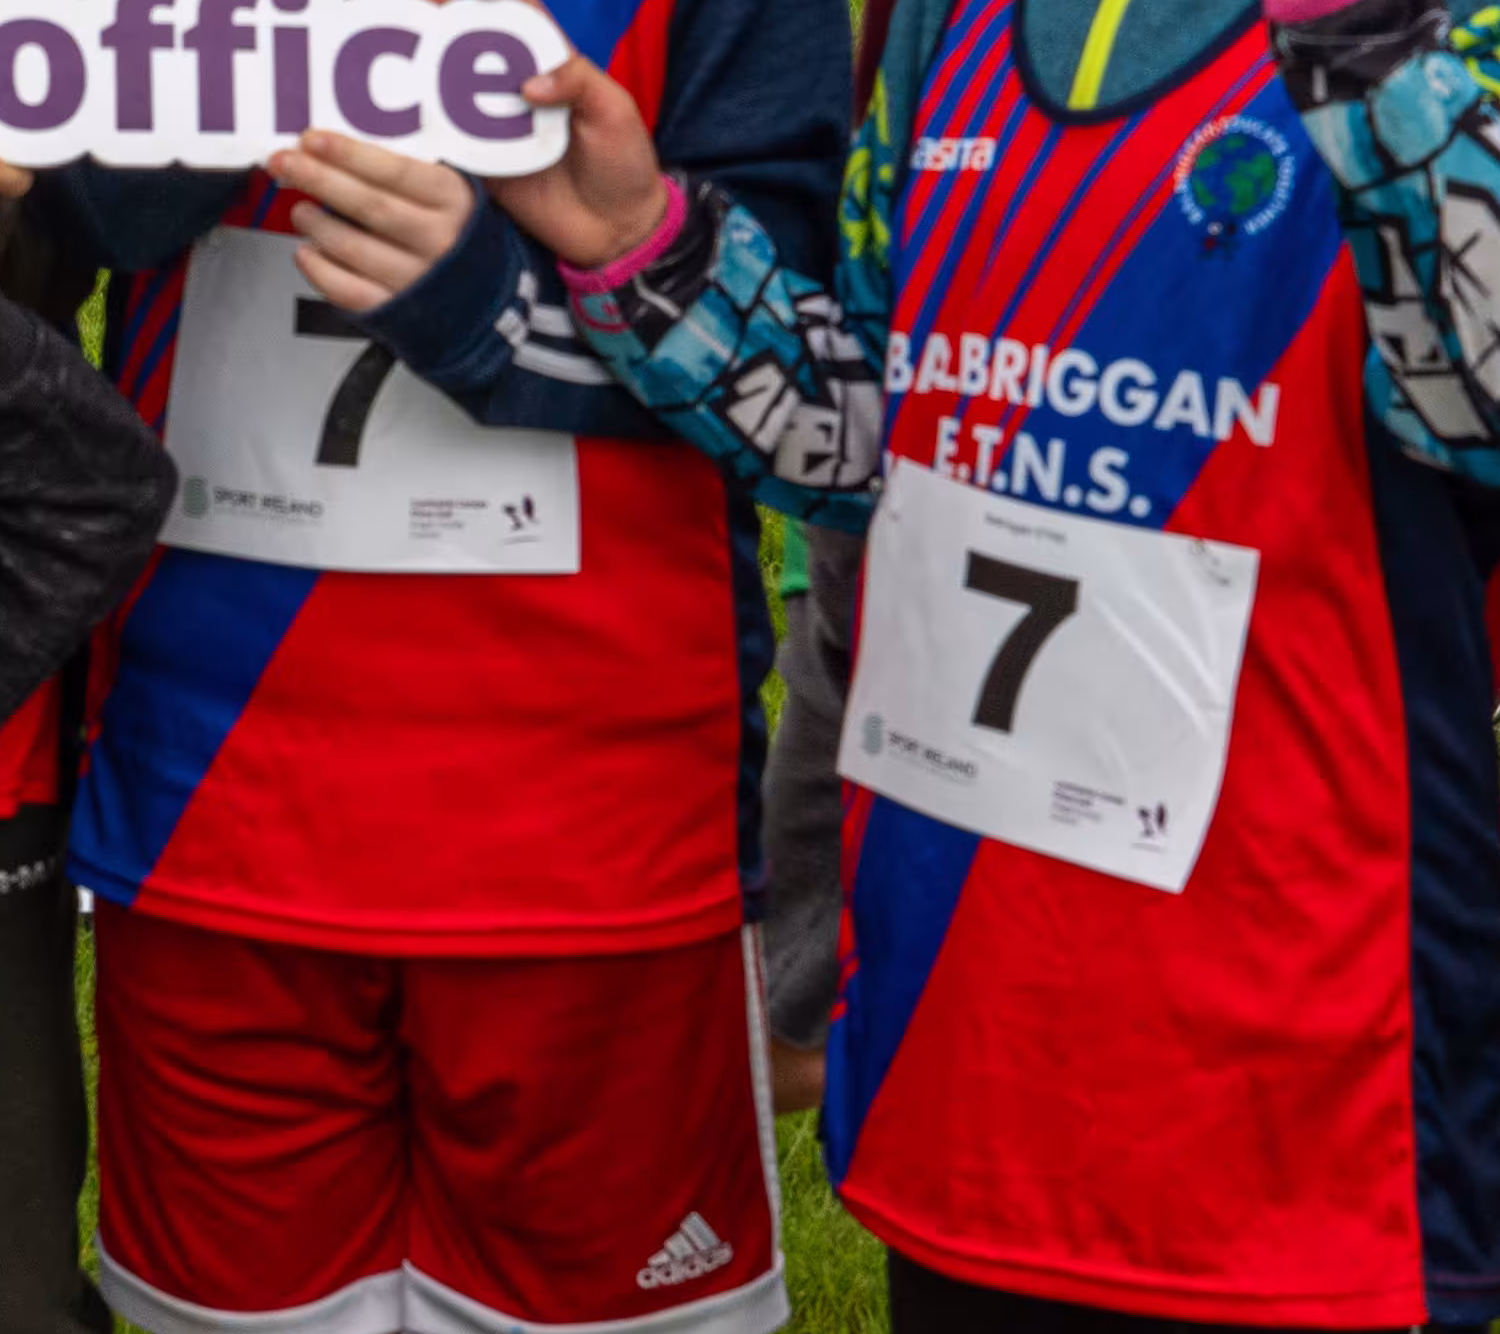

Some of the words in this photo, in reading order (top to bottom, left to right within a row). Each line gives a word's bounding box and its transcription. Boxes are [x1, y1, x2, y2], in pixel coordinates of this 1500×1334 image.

[885, 330, 1280, 448] BABRIGGAN
[934, 416, 1153, 518] E.T.N.S.
[963, 550, 1080, 736] 7
[635, 1241, 734, 1290] adidas
